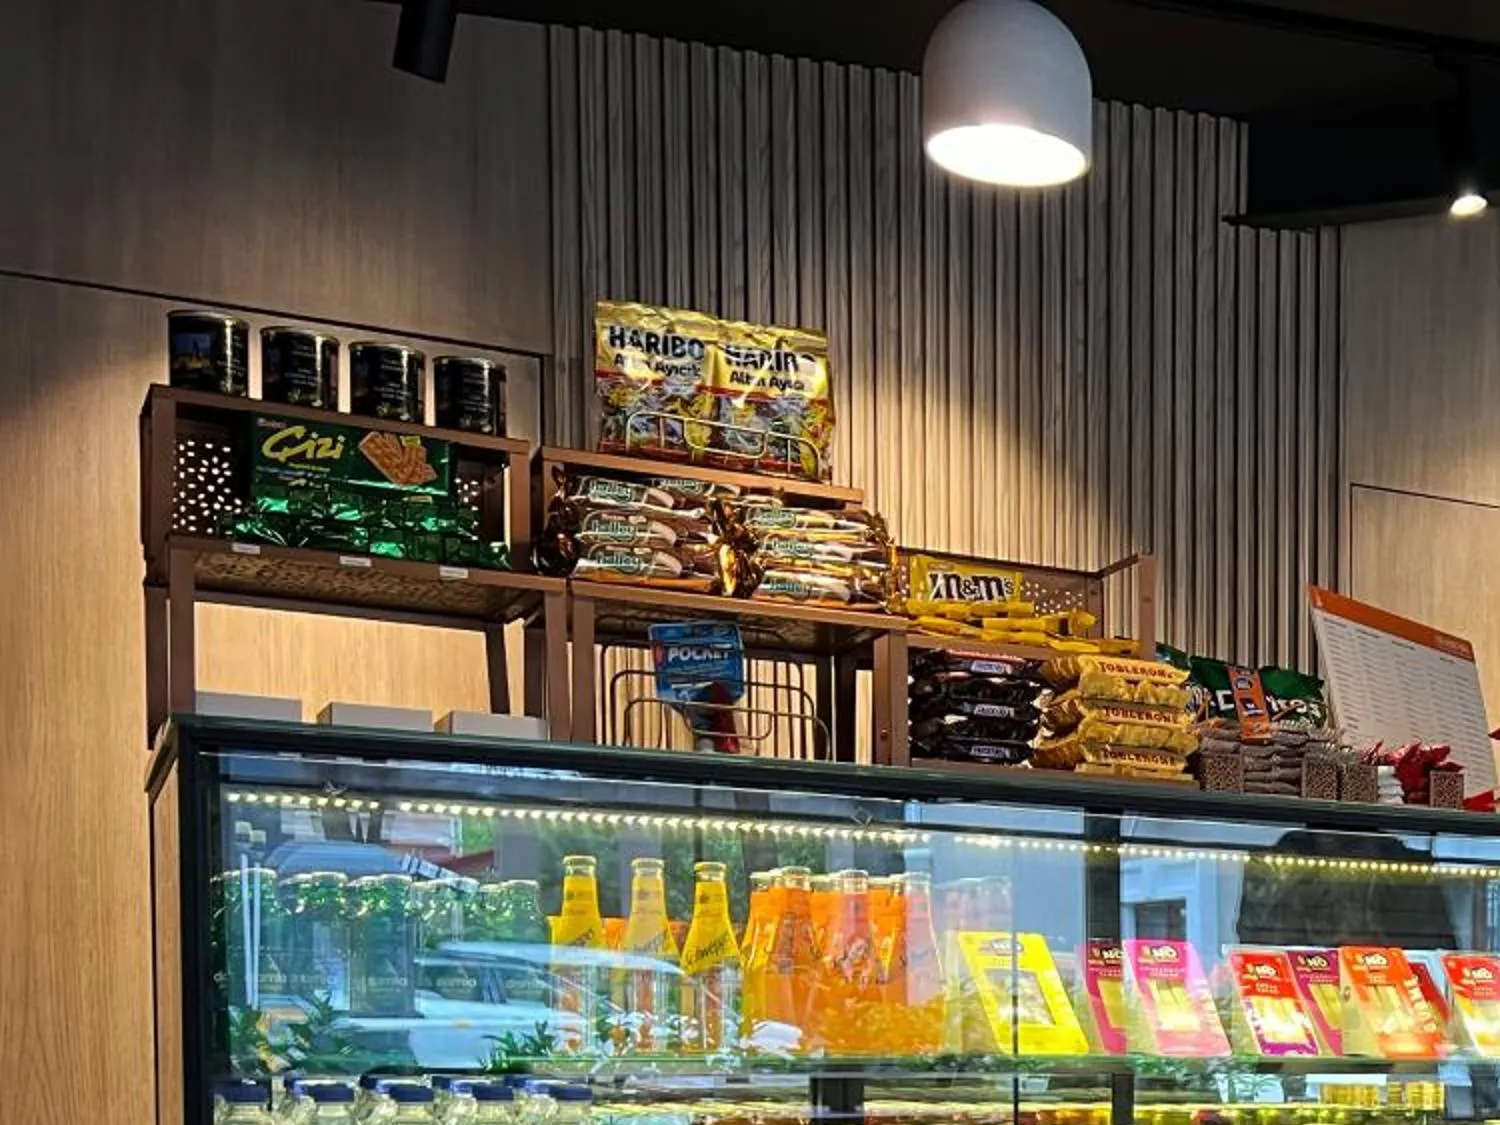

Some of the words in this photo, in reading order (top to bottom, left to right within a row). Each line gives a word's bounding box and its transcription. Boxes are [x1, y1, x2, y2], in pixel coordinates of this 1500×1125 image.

[608, 325, 705, 361] HARIBO
[1098, 661, 1174, 679] TOBLERONE
[1104, 705, 1178, 723] TOBLERONE
[1102, 749, 1176, 766] TOBLERONE
